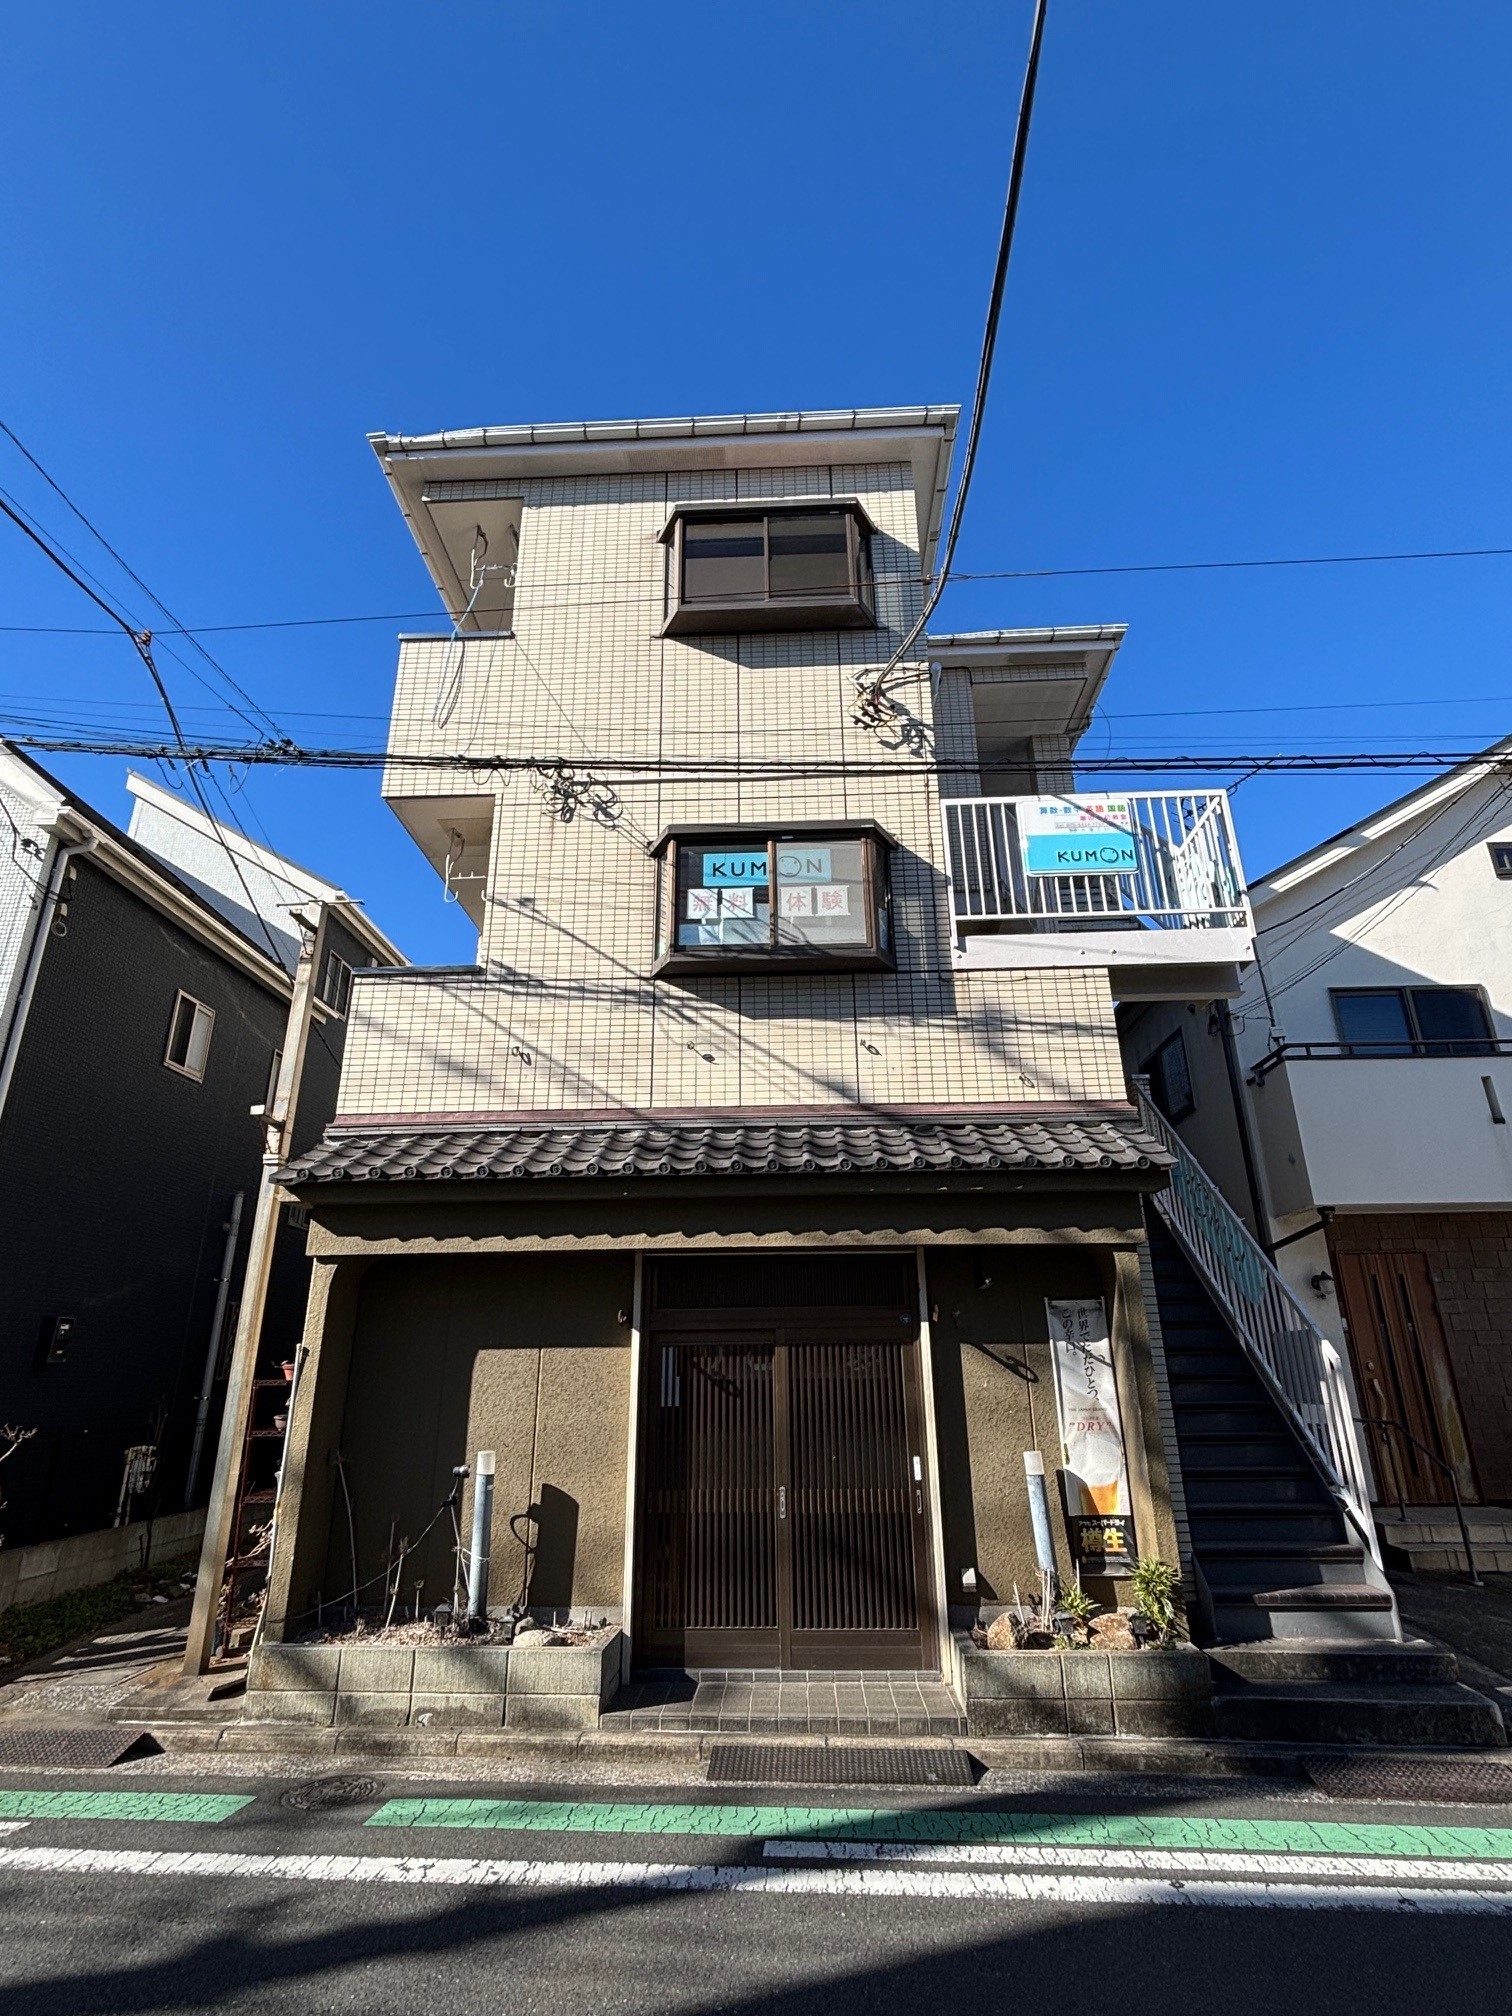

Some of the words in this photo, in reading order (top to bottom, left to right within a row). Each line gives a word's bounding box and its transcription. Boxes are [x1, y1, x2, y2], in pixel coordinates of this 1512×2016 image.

[712, 855, 822, 878] KUMON
[1058, 847, 1133, 863] KUMON
[1081, 1527, 1128, 1553] 樽生
